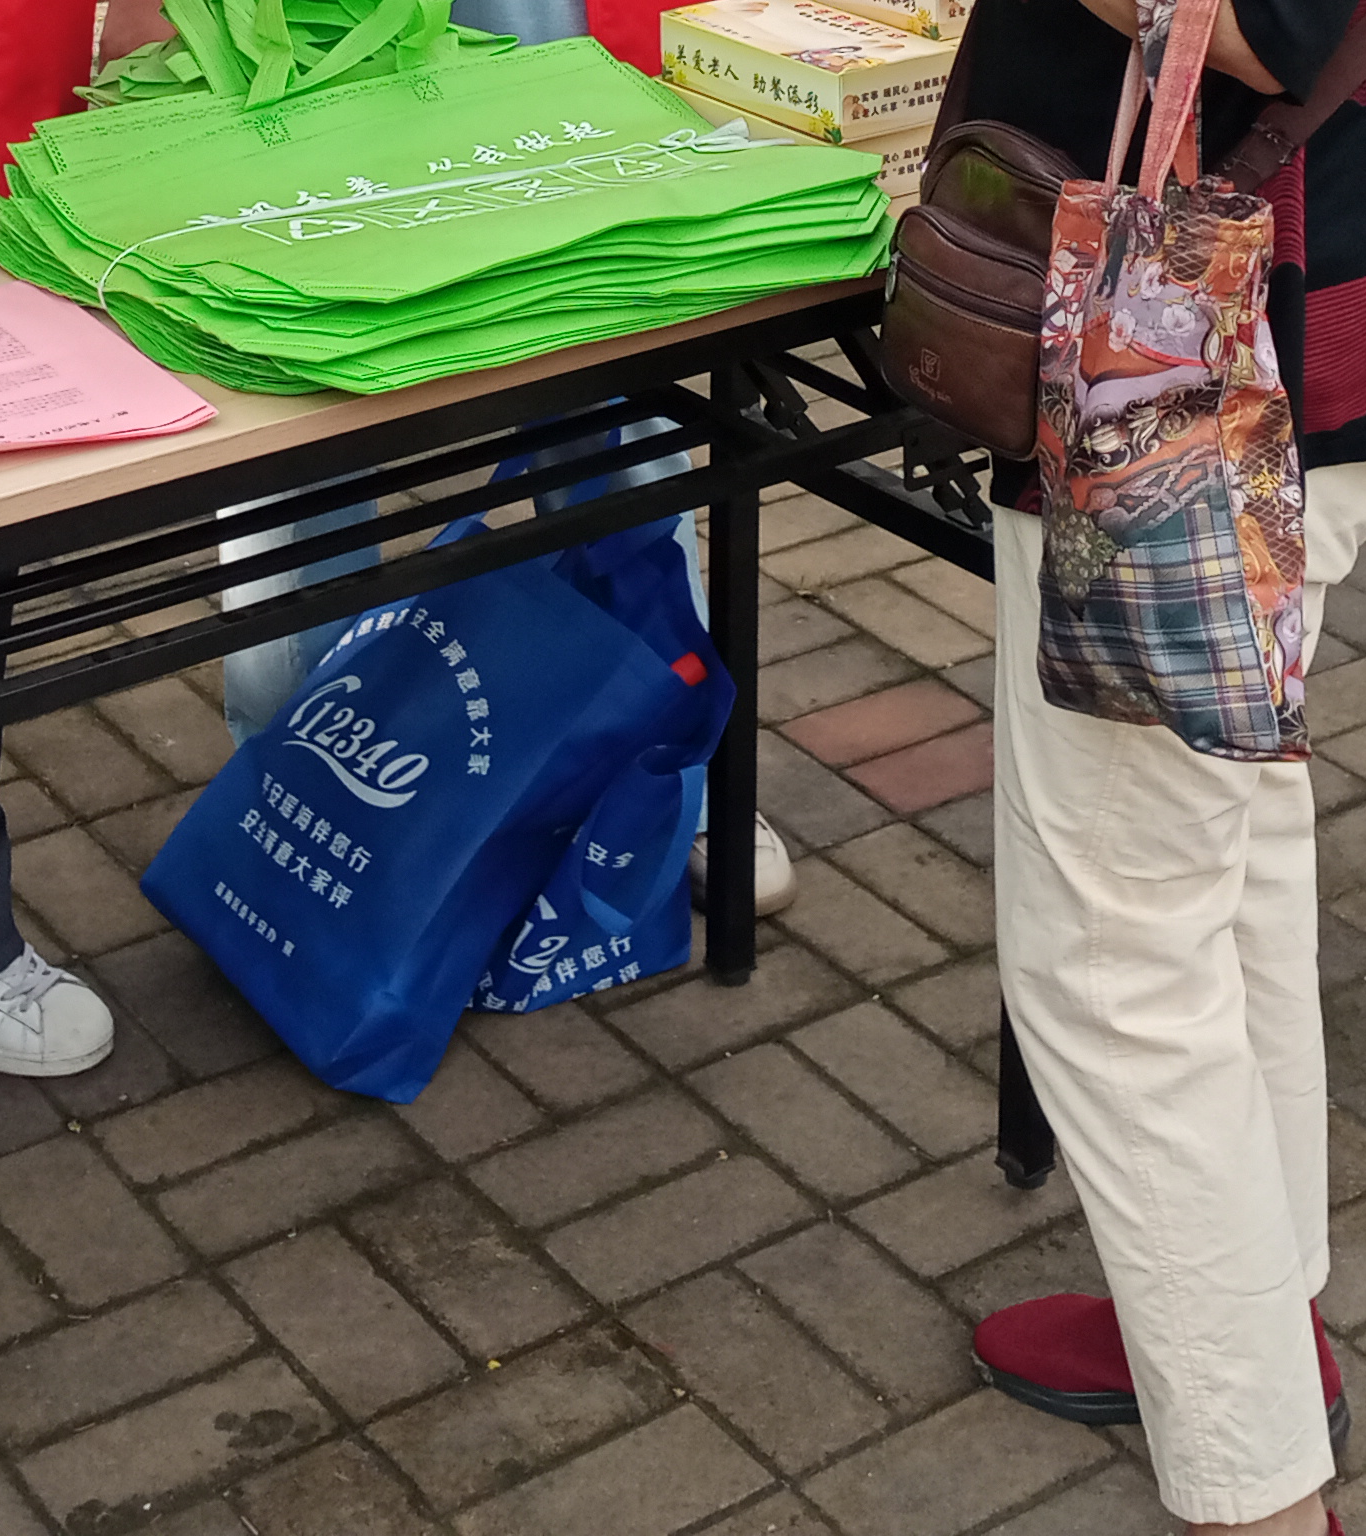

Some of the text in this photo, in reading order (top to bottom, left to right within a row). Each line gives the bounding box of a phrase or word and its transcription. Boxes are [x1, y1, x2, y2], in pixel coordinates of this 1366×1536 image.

[676, 44, 821, 115] 关爱老人 助餐添彩
[293, 700, 430, 790] 12340
[238, 808, 354, 910] 安全满意大家评
